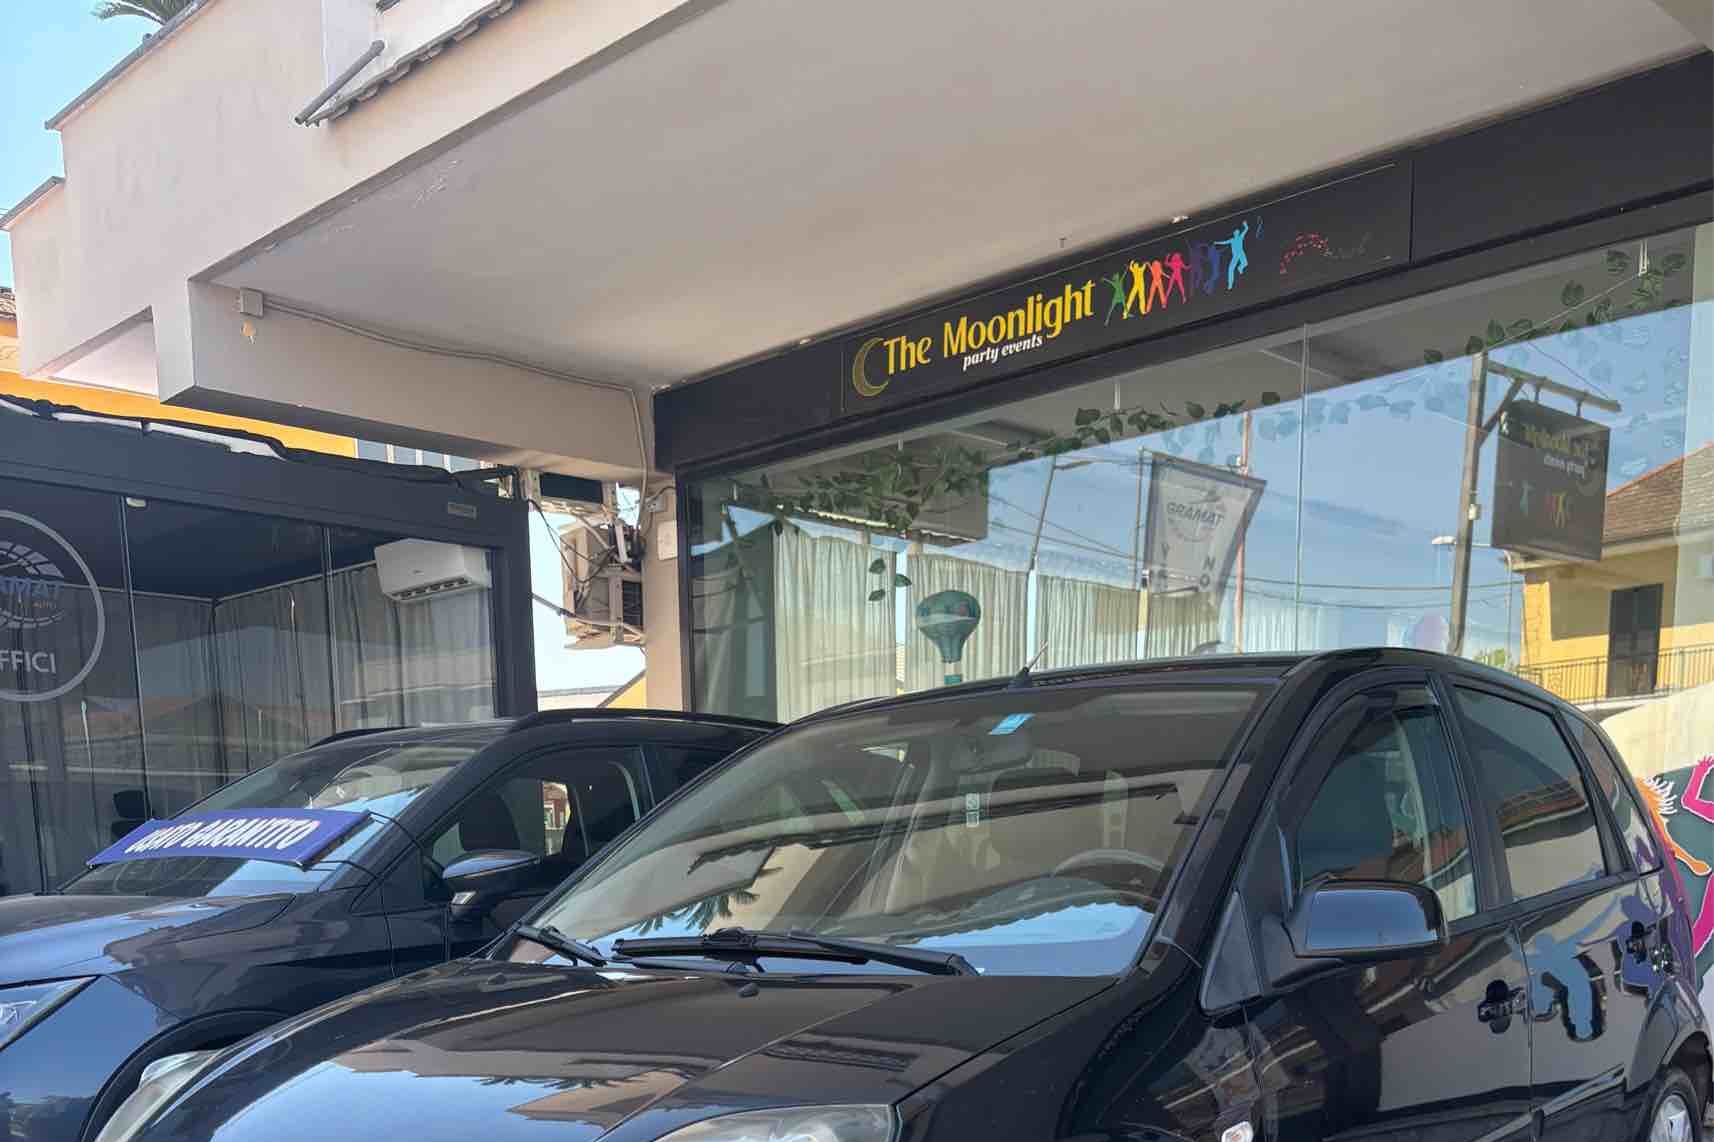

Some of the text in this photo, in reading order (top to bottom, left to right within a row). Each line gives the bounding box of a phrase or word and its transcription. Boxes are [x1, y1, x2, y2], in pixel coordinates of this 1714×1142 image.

[883, 280, 1096, 376] The Moonlight
[963, 334, 1043, 371] party events
